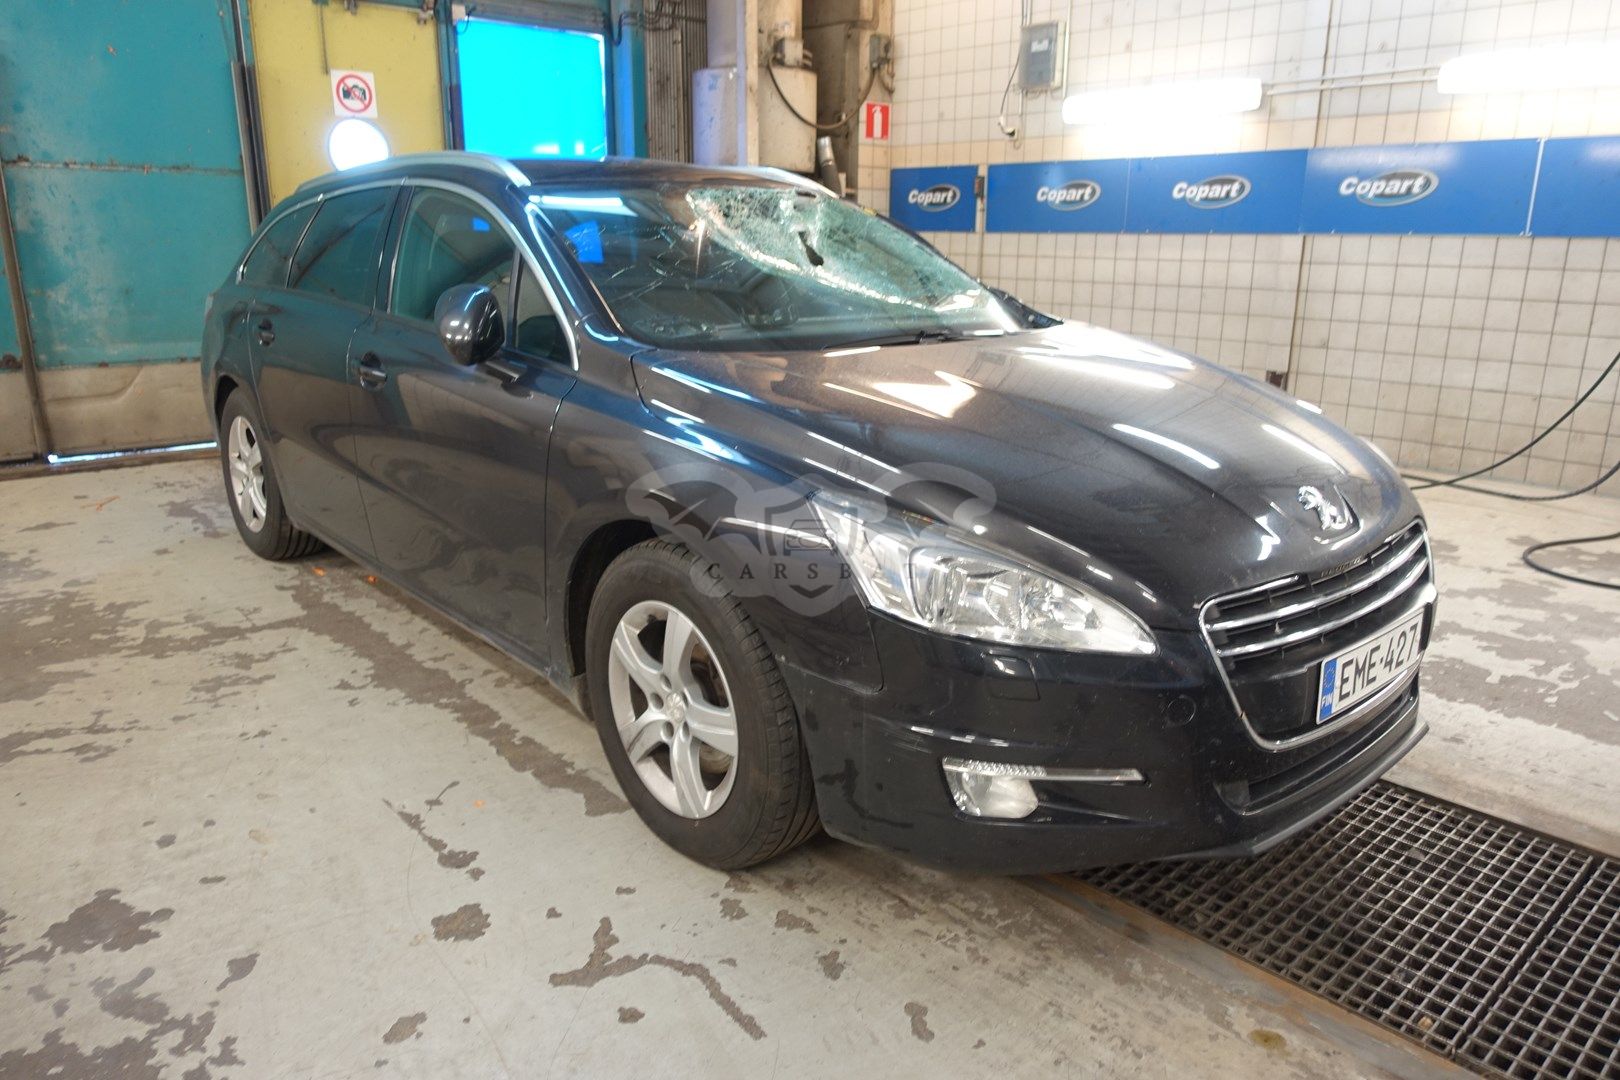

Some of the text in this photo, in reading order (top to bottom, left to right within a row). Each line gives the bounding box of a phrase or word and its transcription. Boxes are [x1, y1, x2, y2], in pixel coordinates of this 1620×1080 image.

[908, 188, 955, 206] Copart
[1036, 185, 1092, 205] Copart
[1172, 181, 1242, 202] Copart
[1338, 175, 1427, 200] Copart
[1339, 623, 1419, 702] EME-427
[1321, 692, 1333, 707] FIN
